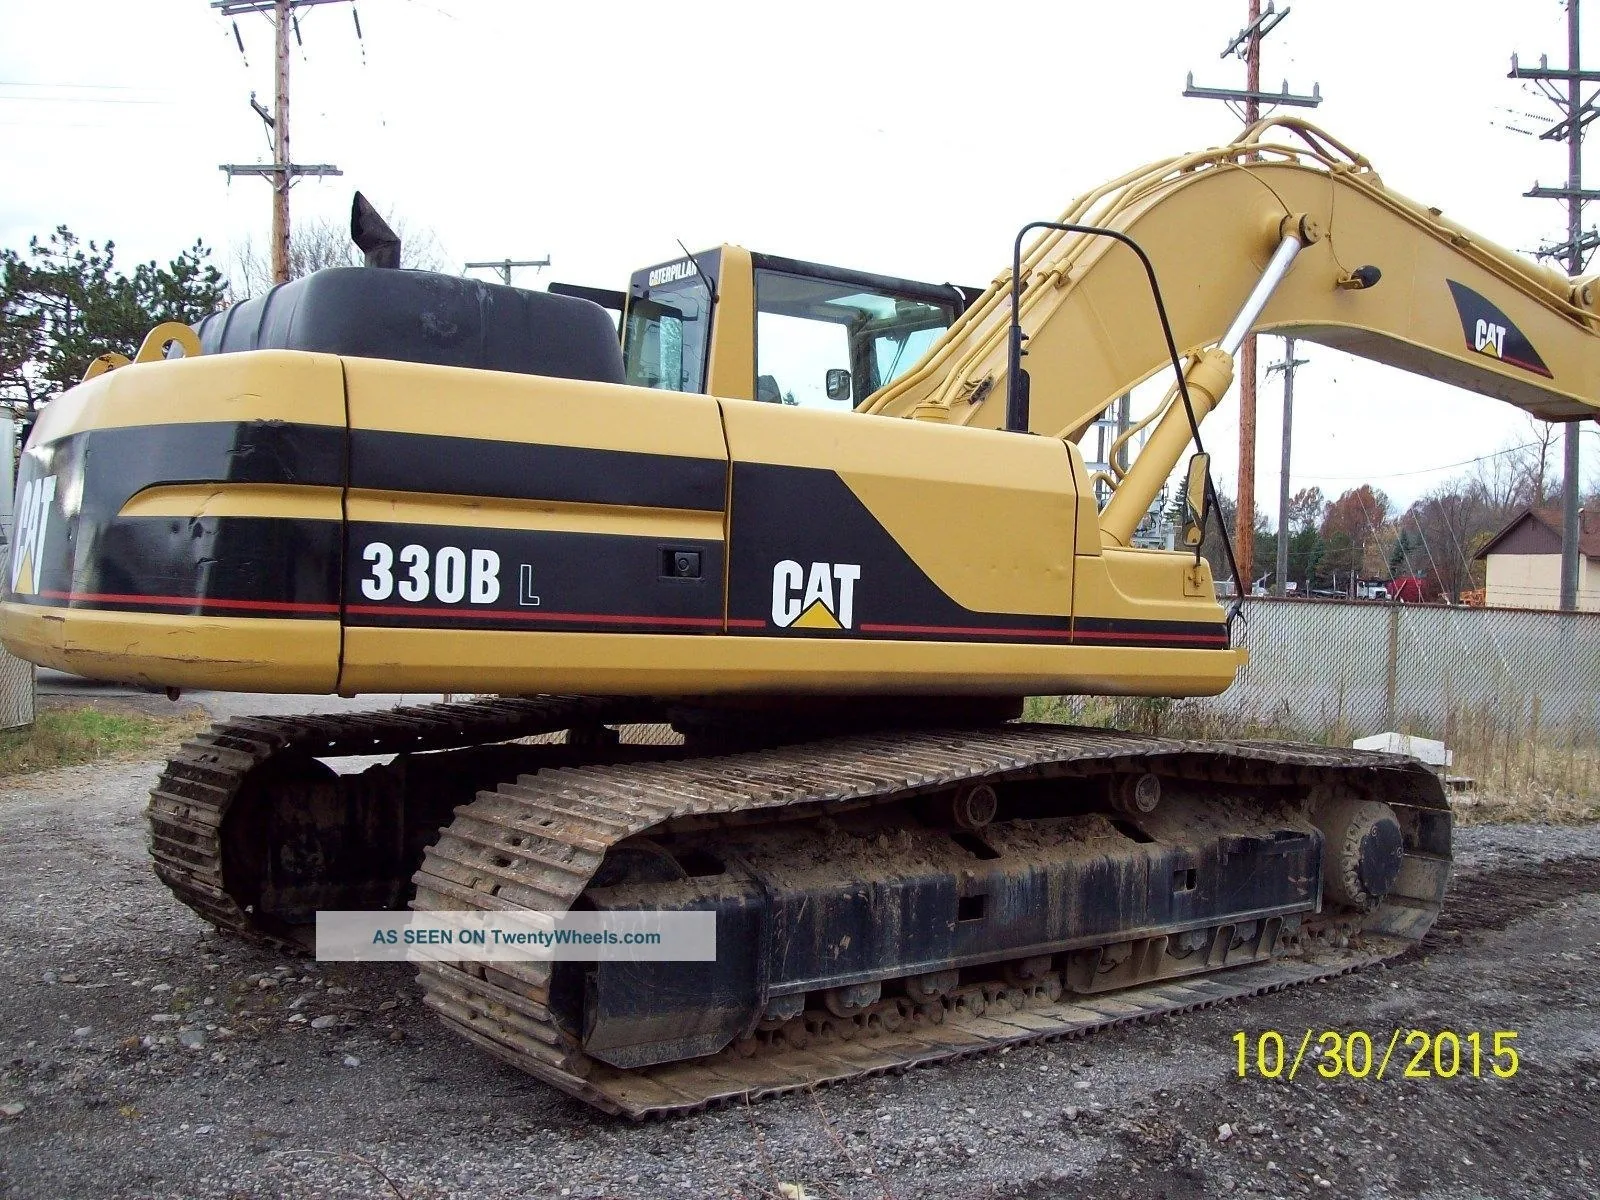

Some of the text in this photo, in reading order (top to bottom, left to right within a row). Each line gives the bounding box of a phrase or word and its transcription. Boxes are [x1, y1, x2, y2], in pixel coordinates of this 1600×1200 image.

[1475, 318, 1506, 359] CAT
[11, 474, 58, 595] CAT
[361, 541, 540, 606] 330B L
[772, 559, 861, 630] CAT
